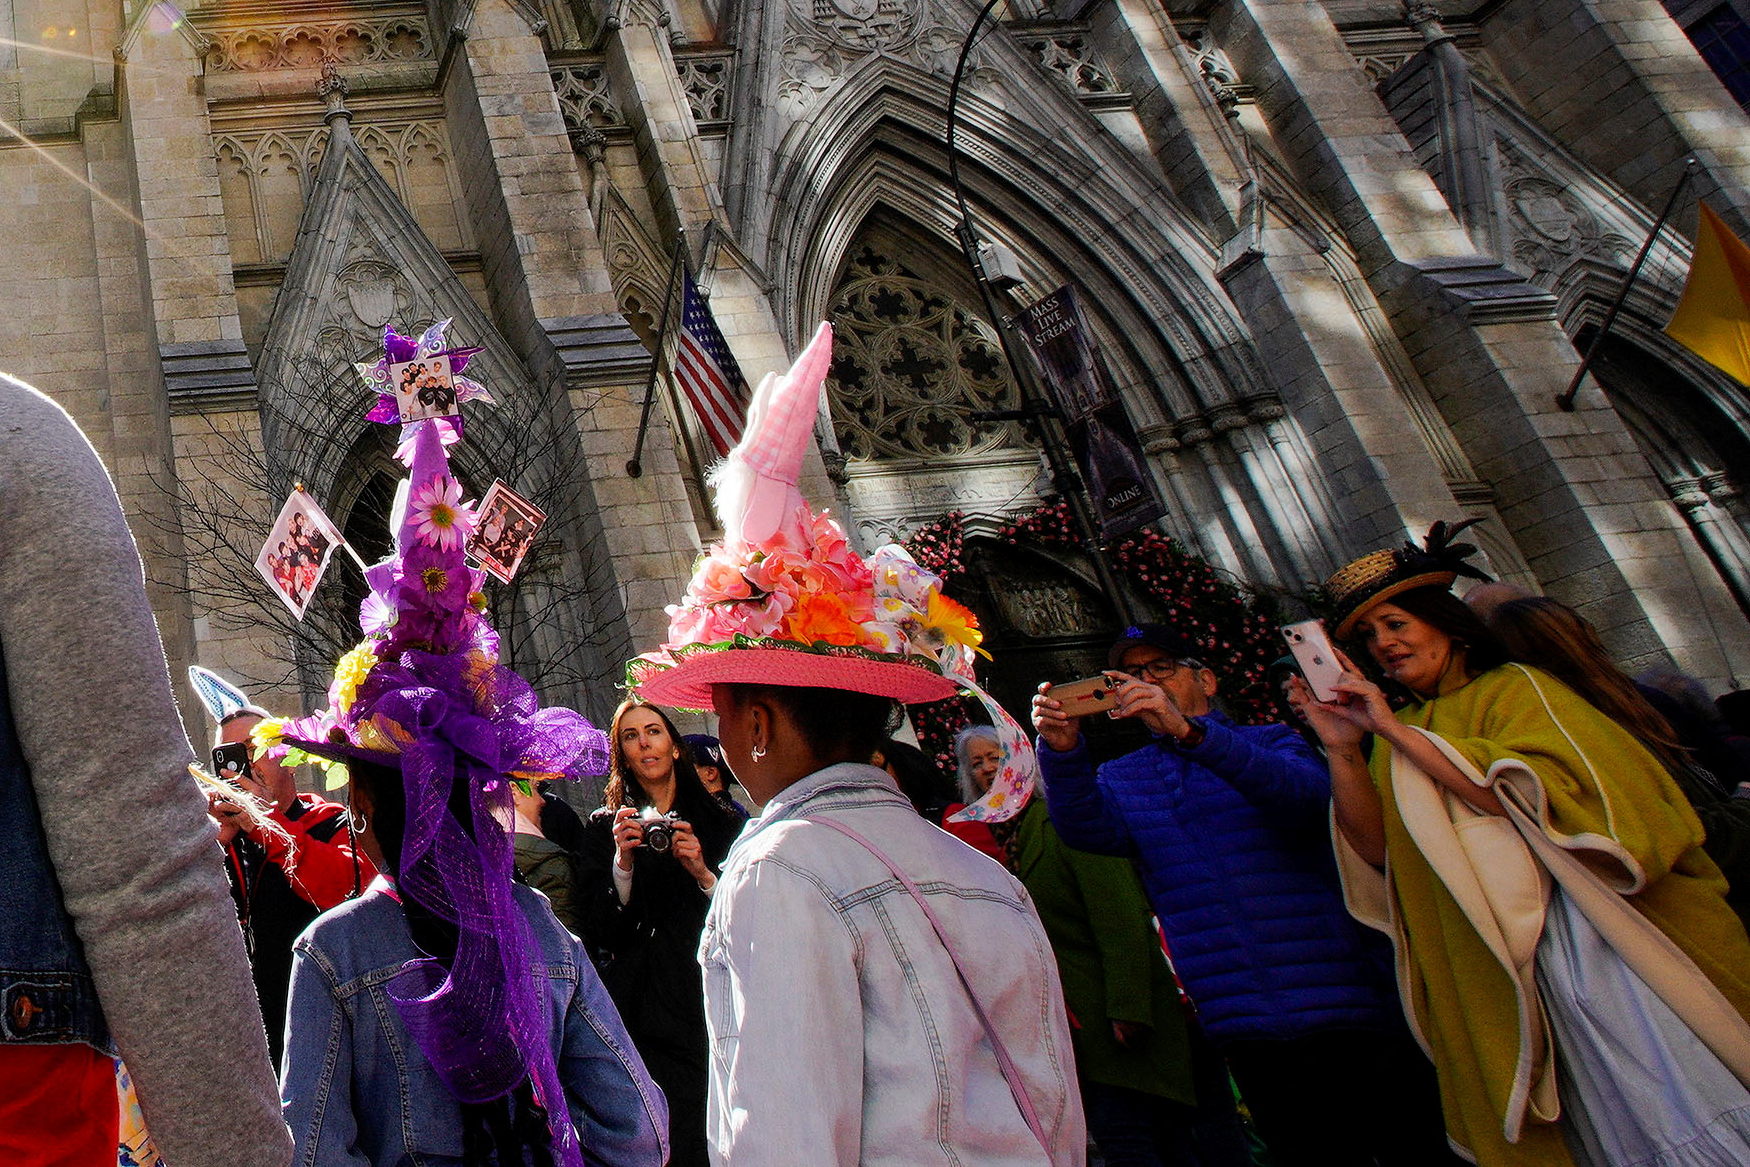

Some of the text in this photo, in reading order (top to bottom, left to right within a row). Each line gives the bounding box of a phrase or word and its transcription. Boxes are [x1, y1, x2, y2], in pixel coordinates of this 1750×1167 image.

[1030, 296, 1059, 320] MASS
[1037, 310, 1062, 330] LIVE
[1034, 317, 1076, 347] STREAM
